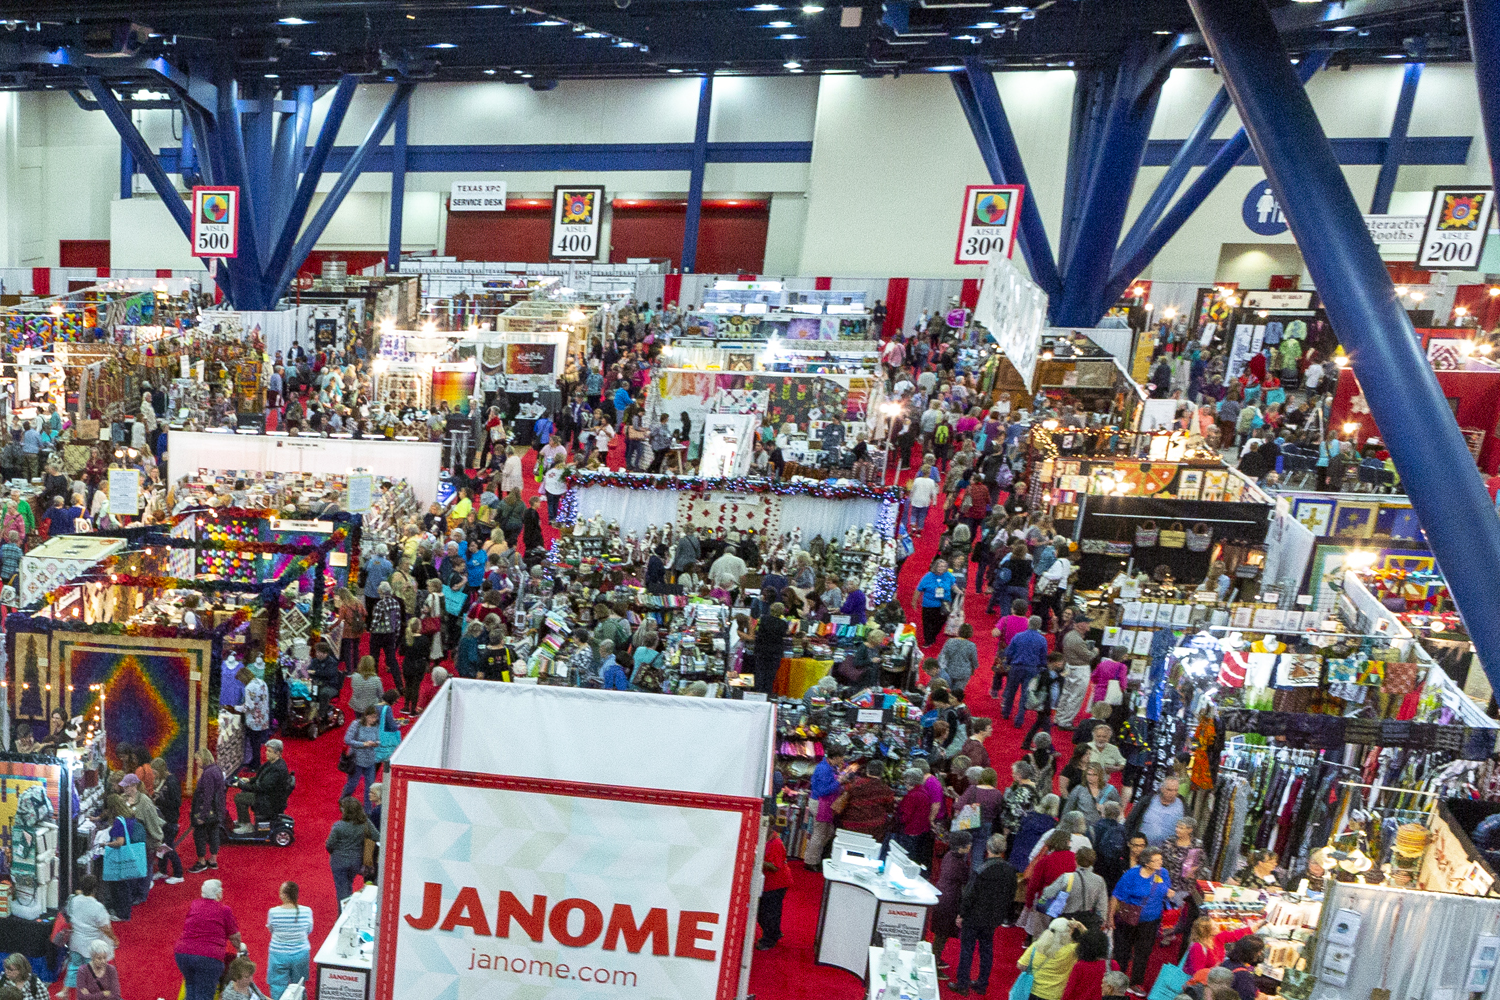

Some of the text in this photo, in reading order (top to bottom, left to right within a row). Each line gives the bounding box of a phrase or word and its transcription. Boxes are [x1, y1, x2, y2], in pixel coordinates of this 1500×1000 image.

[452, 198, 482, 206] SERVICE
[565, 225, 588, 233] AISLE
[1440, 232, 1471, 240] AISLE
[199, 233, 229, 249] 500
[557, 235, 591, 252] 400
[965, 237, 1004, 256] 300
[1427, 242, 1473, 262] 200
[404, 881, 719, 961] JANOME
[467, 946, 638, 987] janome.com
[328, 973, 359, 983] JANOME
